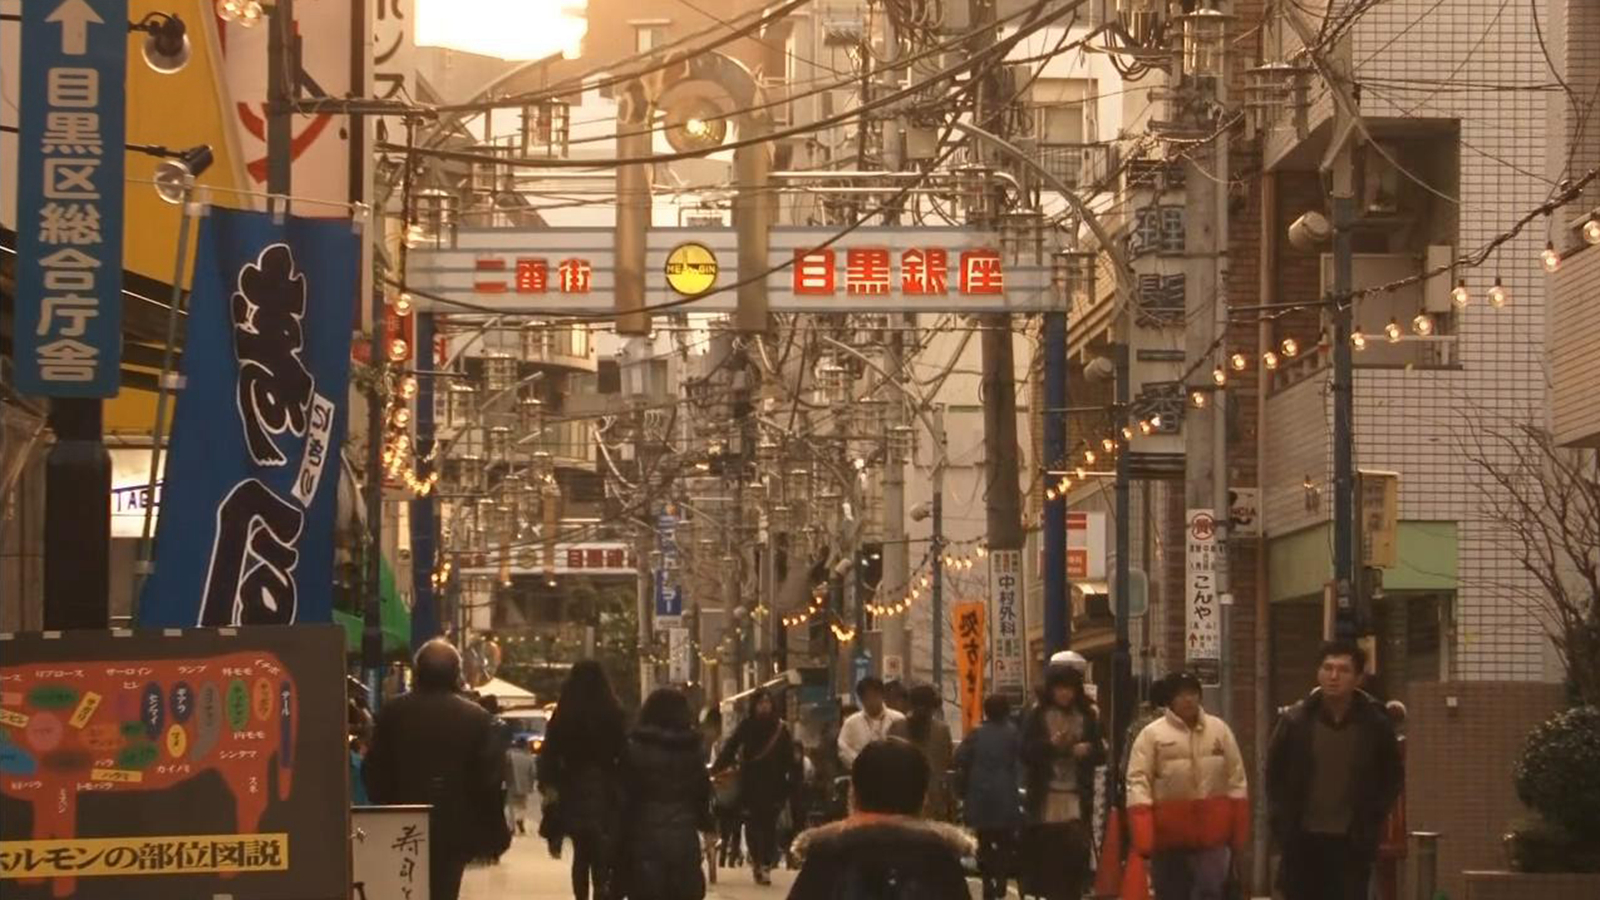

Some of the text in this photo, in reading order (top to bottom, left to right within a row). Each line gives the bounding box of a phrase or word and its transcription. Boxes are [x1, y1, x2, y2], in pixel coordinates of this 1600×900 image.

[36, 67, 103, 381] 目黒区総合庁舎
[474, 257, 592, 294] 二番街
[794, 246, 1004, 295] 目黒銀座
[998, 574, 1017, 636] 中村外科
[1193, 575, 1214, 620] こんや
[106, 667, 153, 675] サーロイン
[149, 693, 160, 725] センマイ
[281, 690, 290, 717] テール
[233, 731, 266, 740] 内モモ
[219, 750, 258, 759] シンタマ
